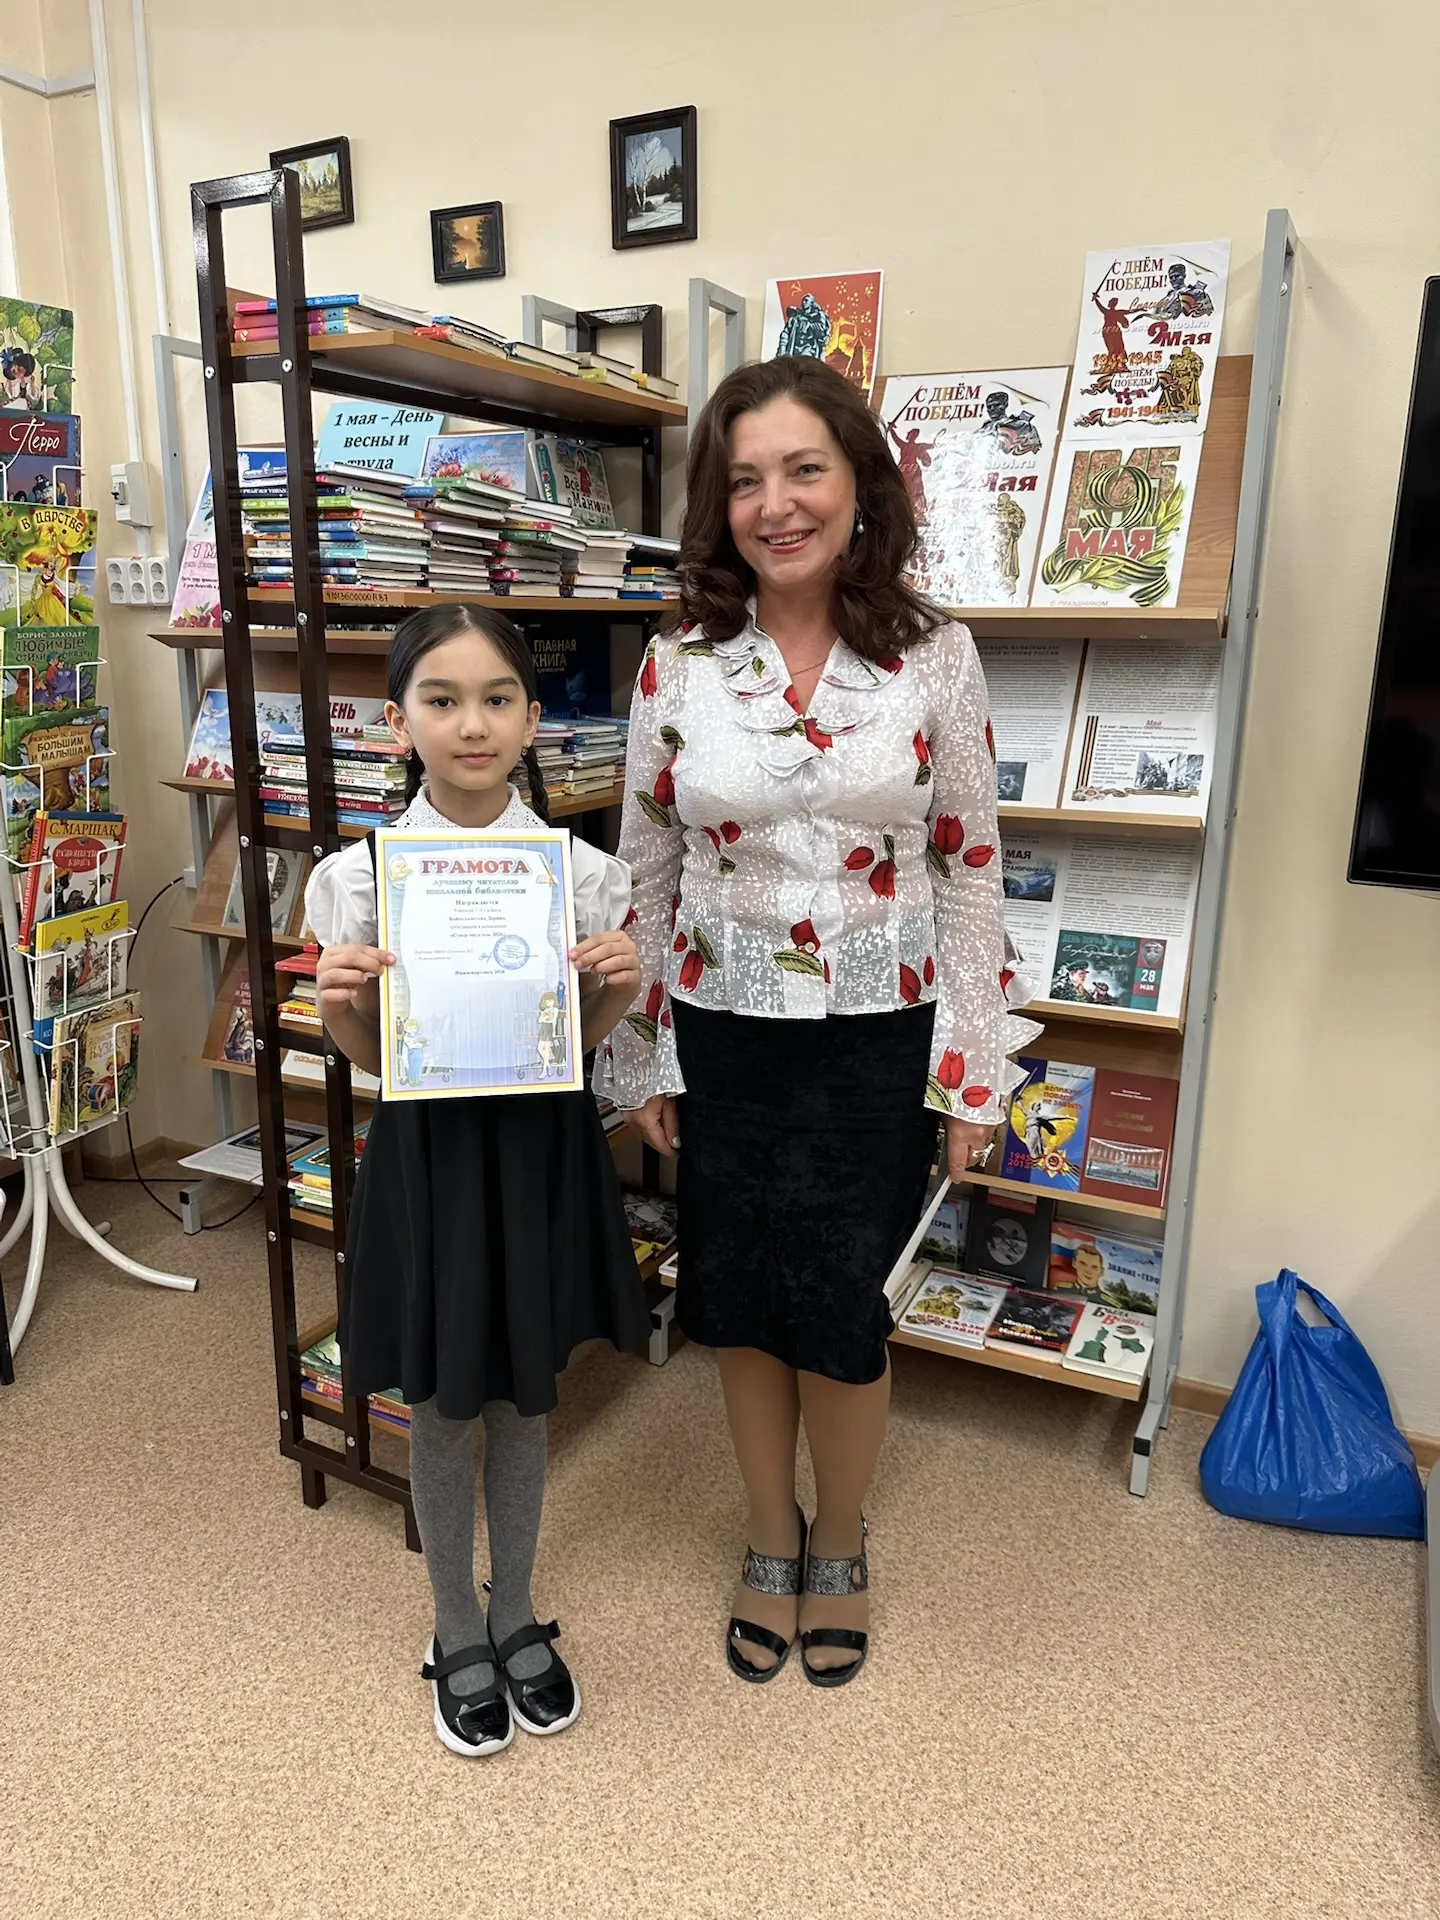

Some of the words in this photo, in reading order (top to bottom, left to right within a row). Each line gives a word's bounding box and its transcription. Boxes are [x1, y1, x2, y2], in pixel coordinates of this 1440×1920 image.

[1112, 262, 1121, 274] С
[1123, 257, 1164, 276] ДНЁМ
[1105, 275, 1168, 292] ПОБЕДЫ!
[1159, 331, 1212, 347] Мая
[928, 383, 982, 404] ДНЁМ
[334, 413, 344, 426] 1
[346, 414, 378, 426] мая
[391, 409, 434, 427] День
[904, 404, 984, 422] ПОБЕДЫ!
[343, 435, 395, 448] весны
[398, 434, 410, 446] и
[21, 518, 31, 530] В
[35, 511, 83, 533] ЦАРСТВЕ
[1065, 526, 1158, 561] МАЯ
[17, 631, 47, 639] БОРИС
[534, 639, 577, 651] ГЛАВНАЯ
[532, 653, 567, 667] КНИГА
[330, 702, 356, 719] ЕНЬ
[37, 737, 84, 752] БОЛЬШИМ
[42, 746, 91, 762] МАЛЫШАМ
[62, 820, 118, 837] МАРШАК
[1005, 849, 1031, 860] МАЯ
[421, 859, 531, 875] ГРАМОТА
[1140, 969, 1156, 982] 28
[1141, 1272, 1160, 1284] ГЕРО
